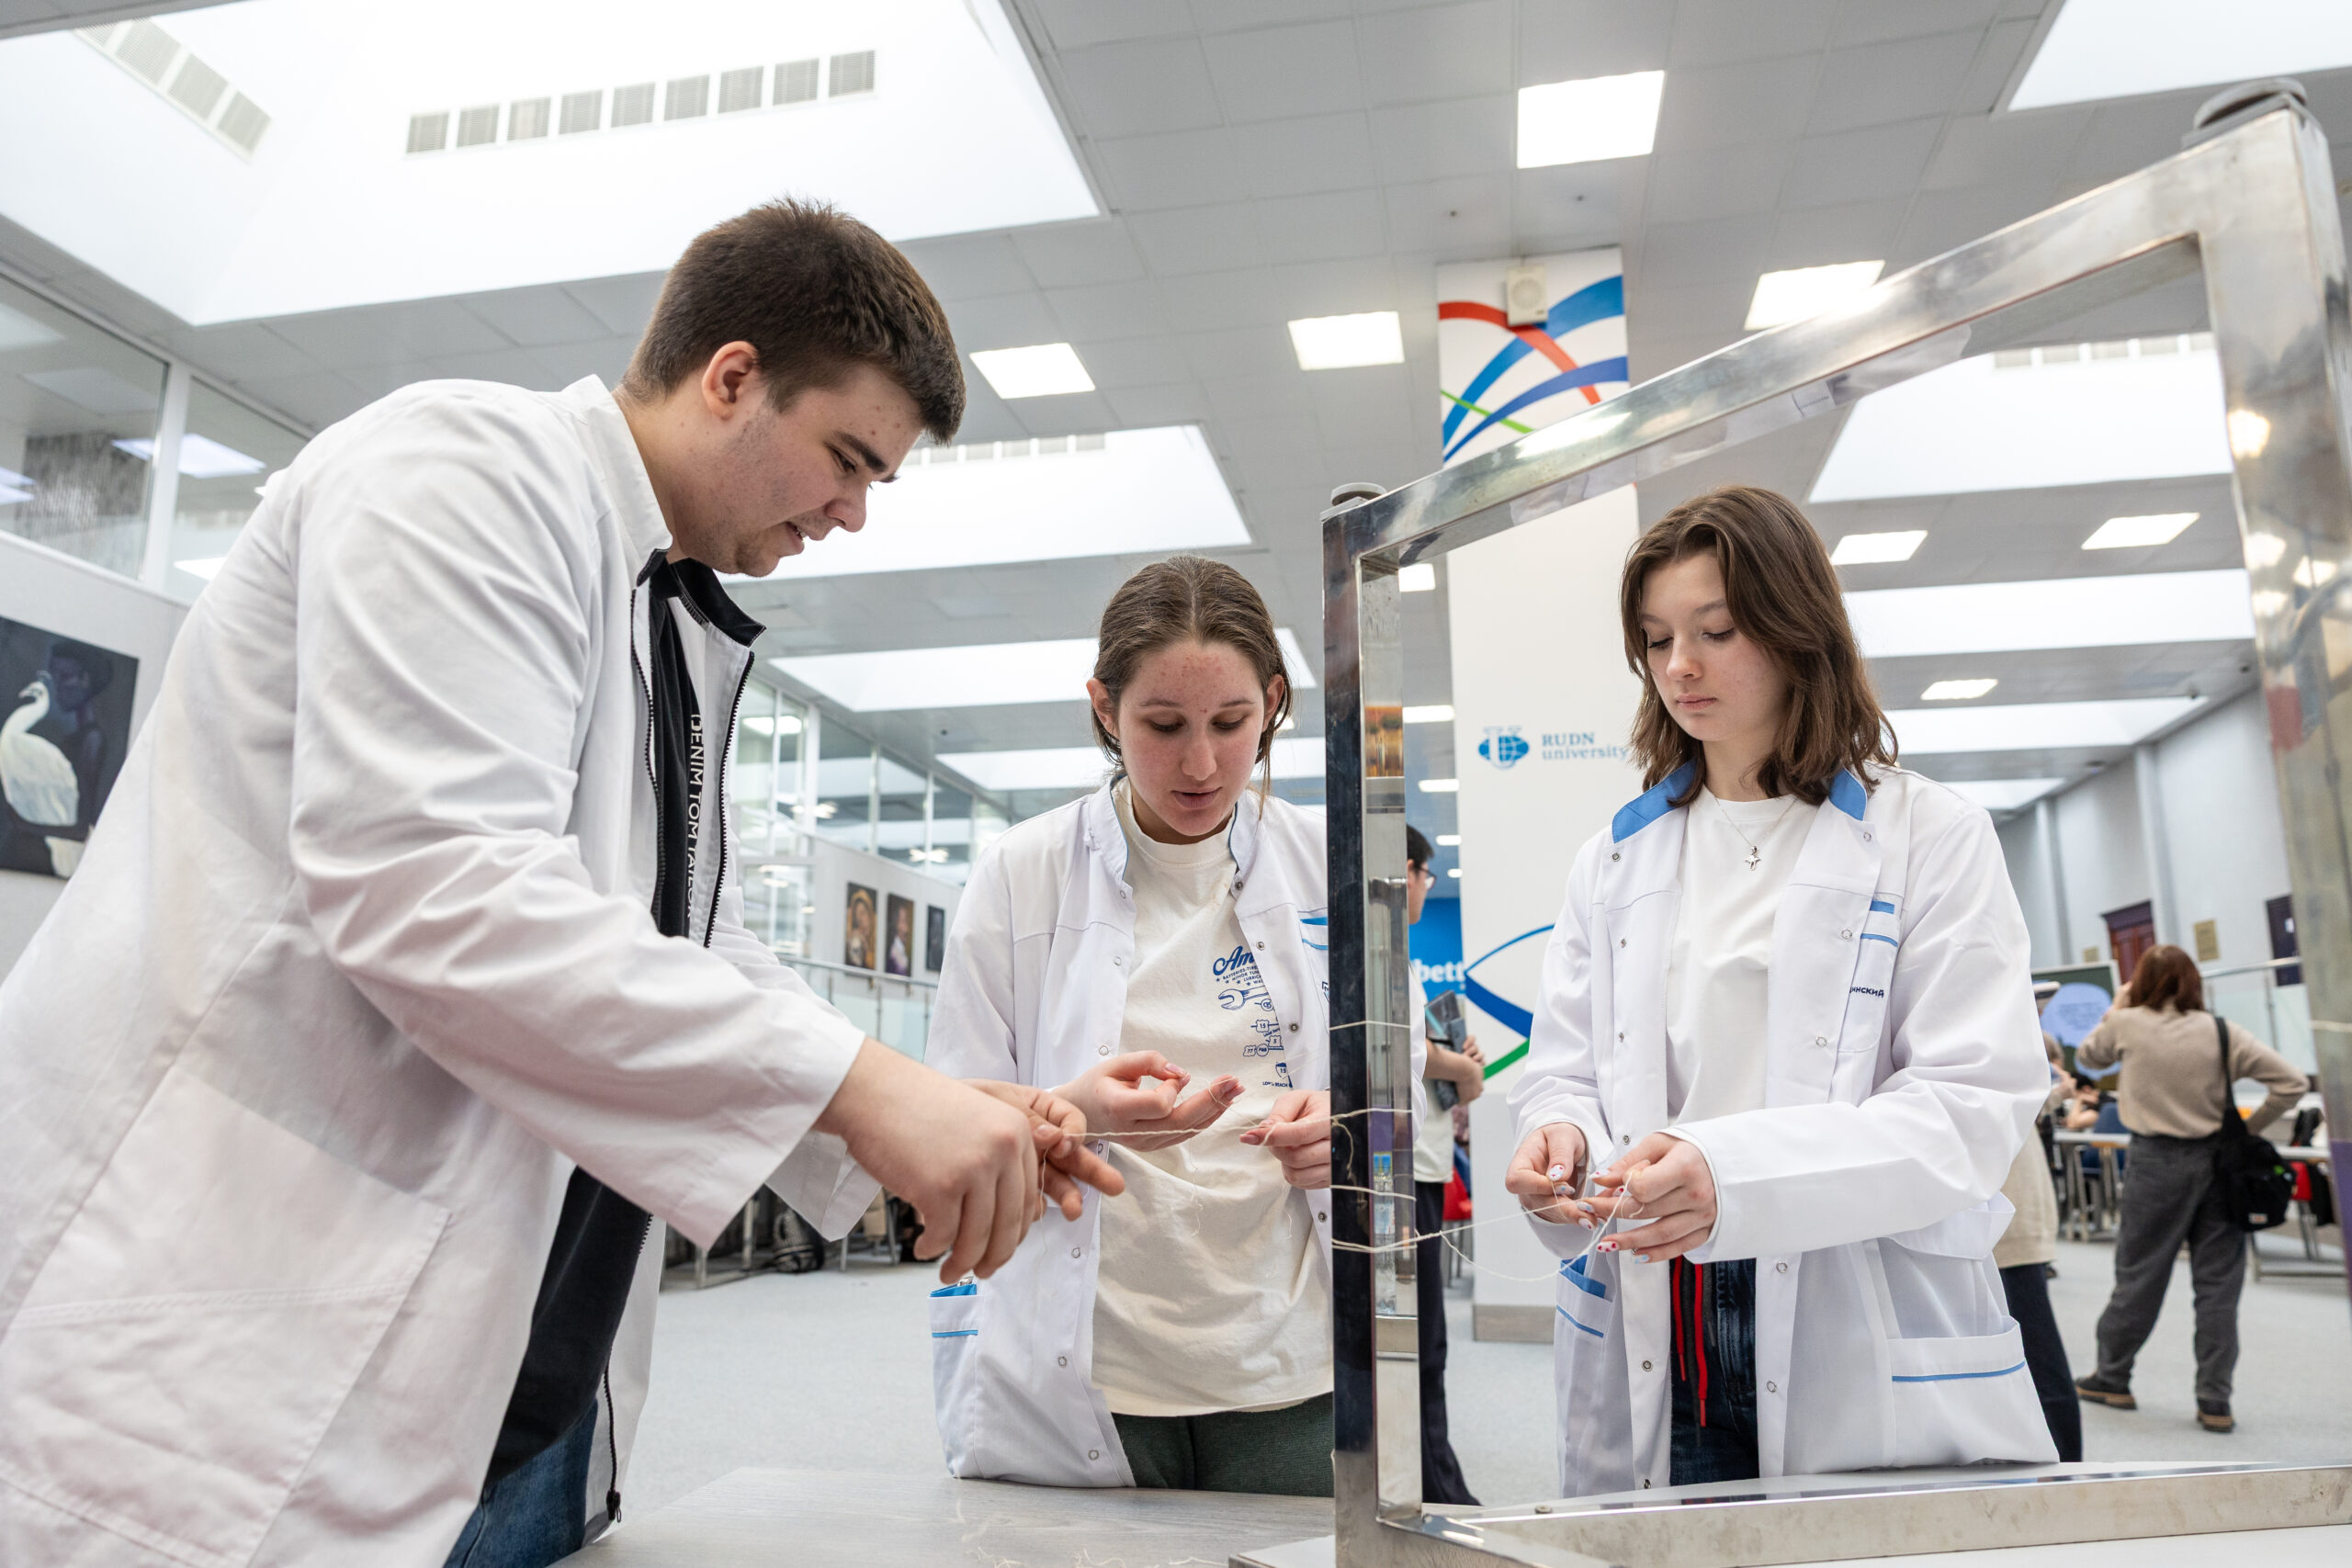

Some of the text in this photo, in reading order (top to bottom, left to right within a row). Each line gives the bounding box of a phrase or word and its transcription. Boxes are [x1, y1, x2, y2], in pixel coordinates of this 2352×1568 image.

[690, 714, 704, 785] DENIM
[1541, 732, 1596, 746] RUDN
[1542, 744, 1628, 761] university
[688, 791, 702, 840] TOM
